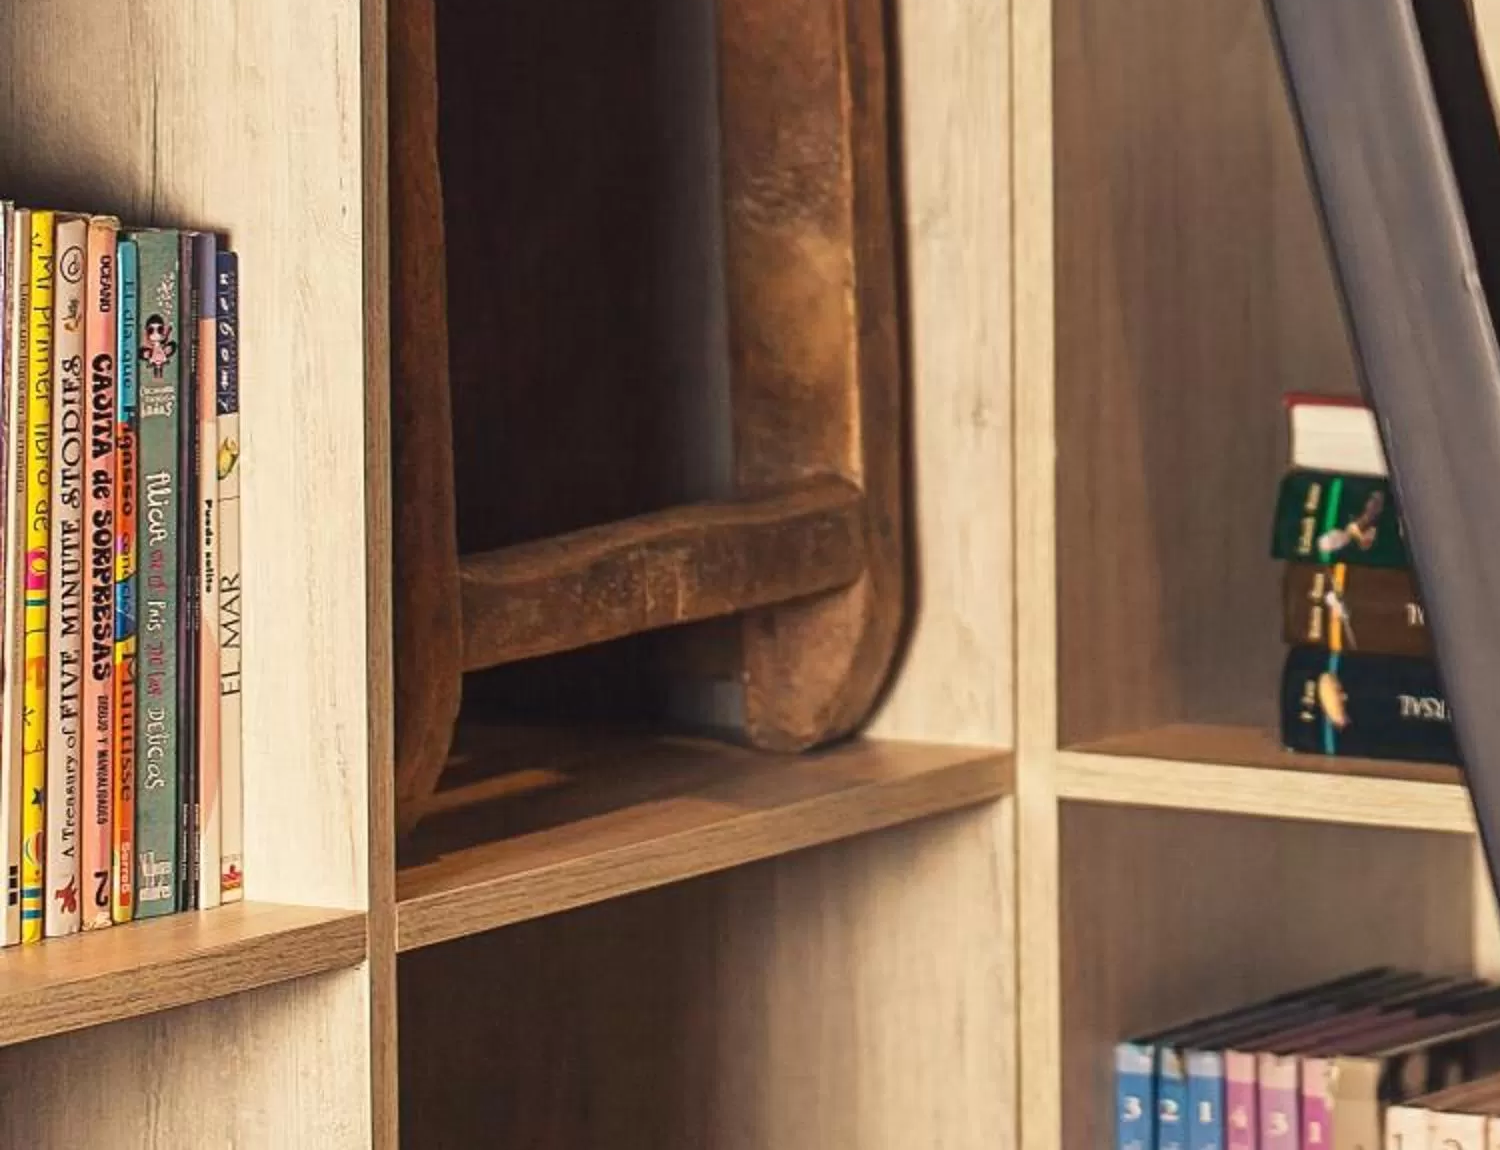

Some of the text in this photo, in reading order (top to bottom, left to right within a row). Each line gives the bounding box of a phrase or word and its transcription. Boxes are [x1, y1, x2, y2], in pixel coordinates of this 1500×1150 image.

[99, 254, 112, 313] OCEANO
[33, 305, 54, 411] primer
[34, 422, 53, 487] libro
[60, 355, 82, 509] STORIES
[90, 353, 114, 682] CAJITA de SORPRESAS
[60, 518, 82, 639] MINUTE
[220, 573, 242, 696] EL MAR
[60, 651, 81, 720] FIVE
[61, 726, 77, 748] of
[61, 755, 78, 842] Treasury
[94, 871, 109, 907] 2
[1123, 1096, 1143, 1123] 3
[1159, 1099, 1181, 1123] 2
[1199, 1101, 1213, 1123] 1
[1269, 1111, 1290, 1136] 3
[1307, 1121, 1322, 1144] 1
